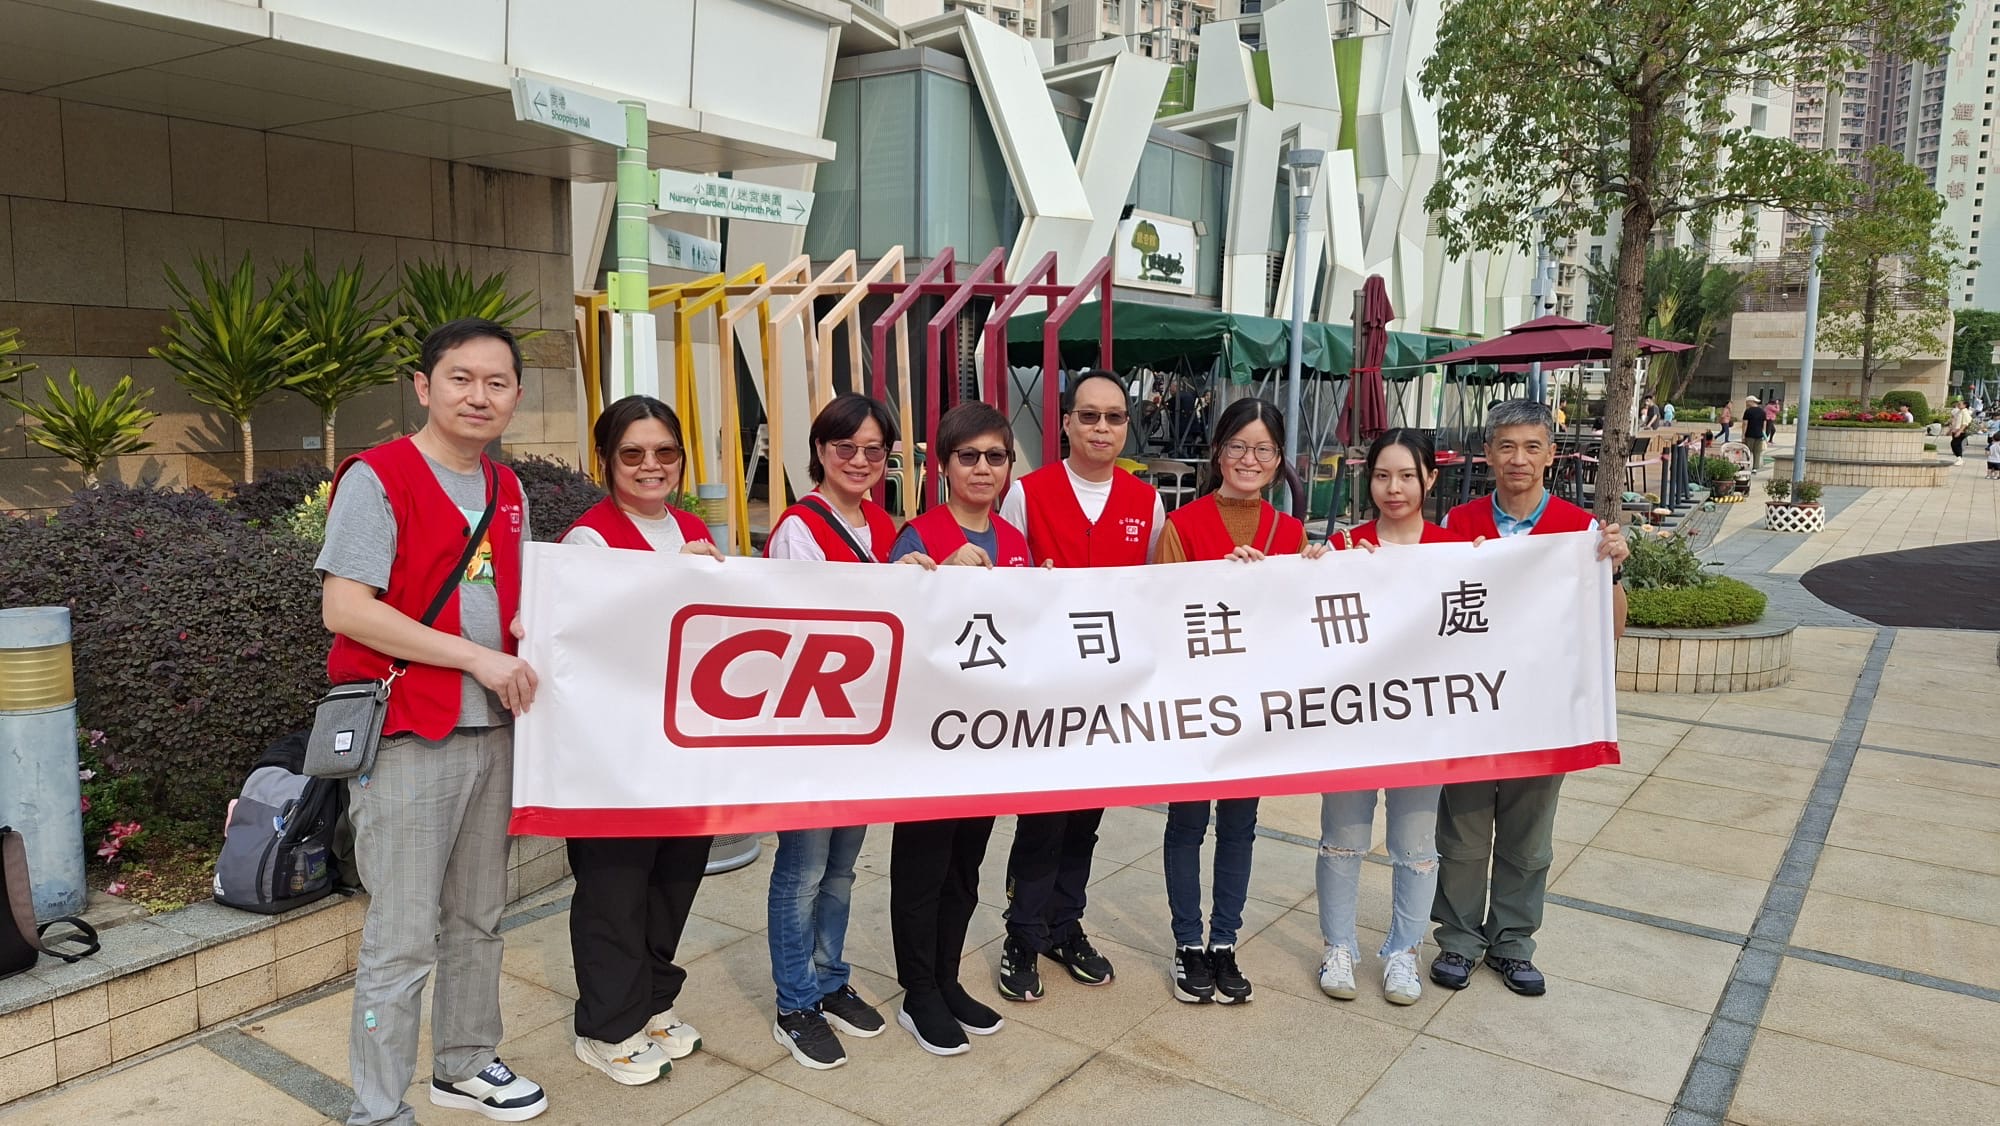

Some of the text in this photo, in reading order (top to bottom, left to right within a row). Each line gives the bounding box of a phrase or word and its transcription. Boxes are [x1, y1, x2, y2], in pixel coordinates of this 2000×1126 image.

[551, 110, 578, 128] Shopping
[669, 192, 698, 206] Nursery
[699, 196, 726, 209] Garden
[731, 201, 765, 216] Labyrinth
[766, 206, 782, 217] Park
[955, 580, 1490, 671] 公司註冊處
[690, 629, 875, 721] CR
[931, 670, 1507, 751] COMPANIES REGISTRY
